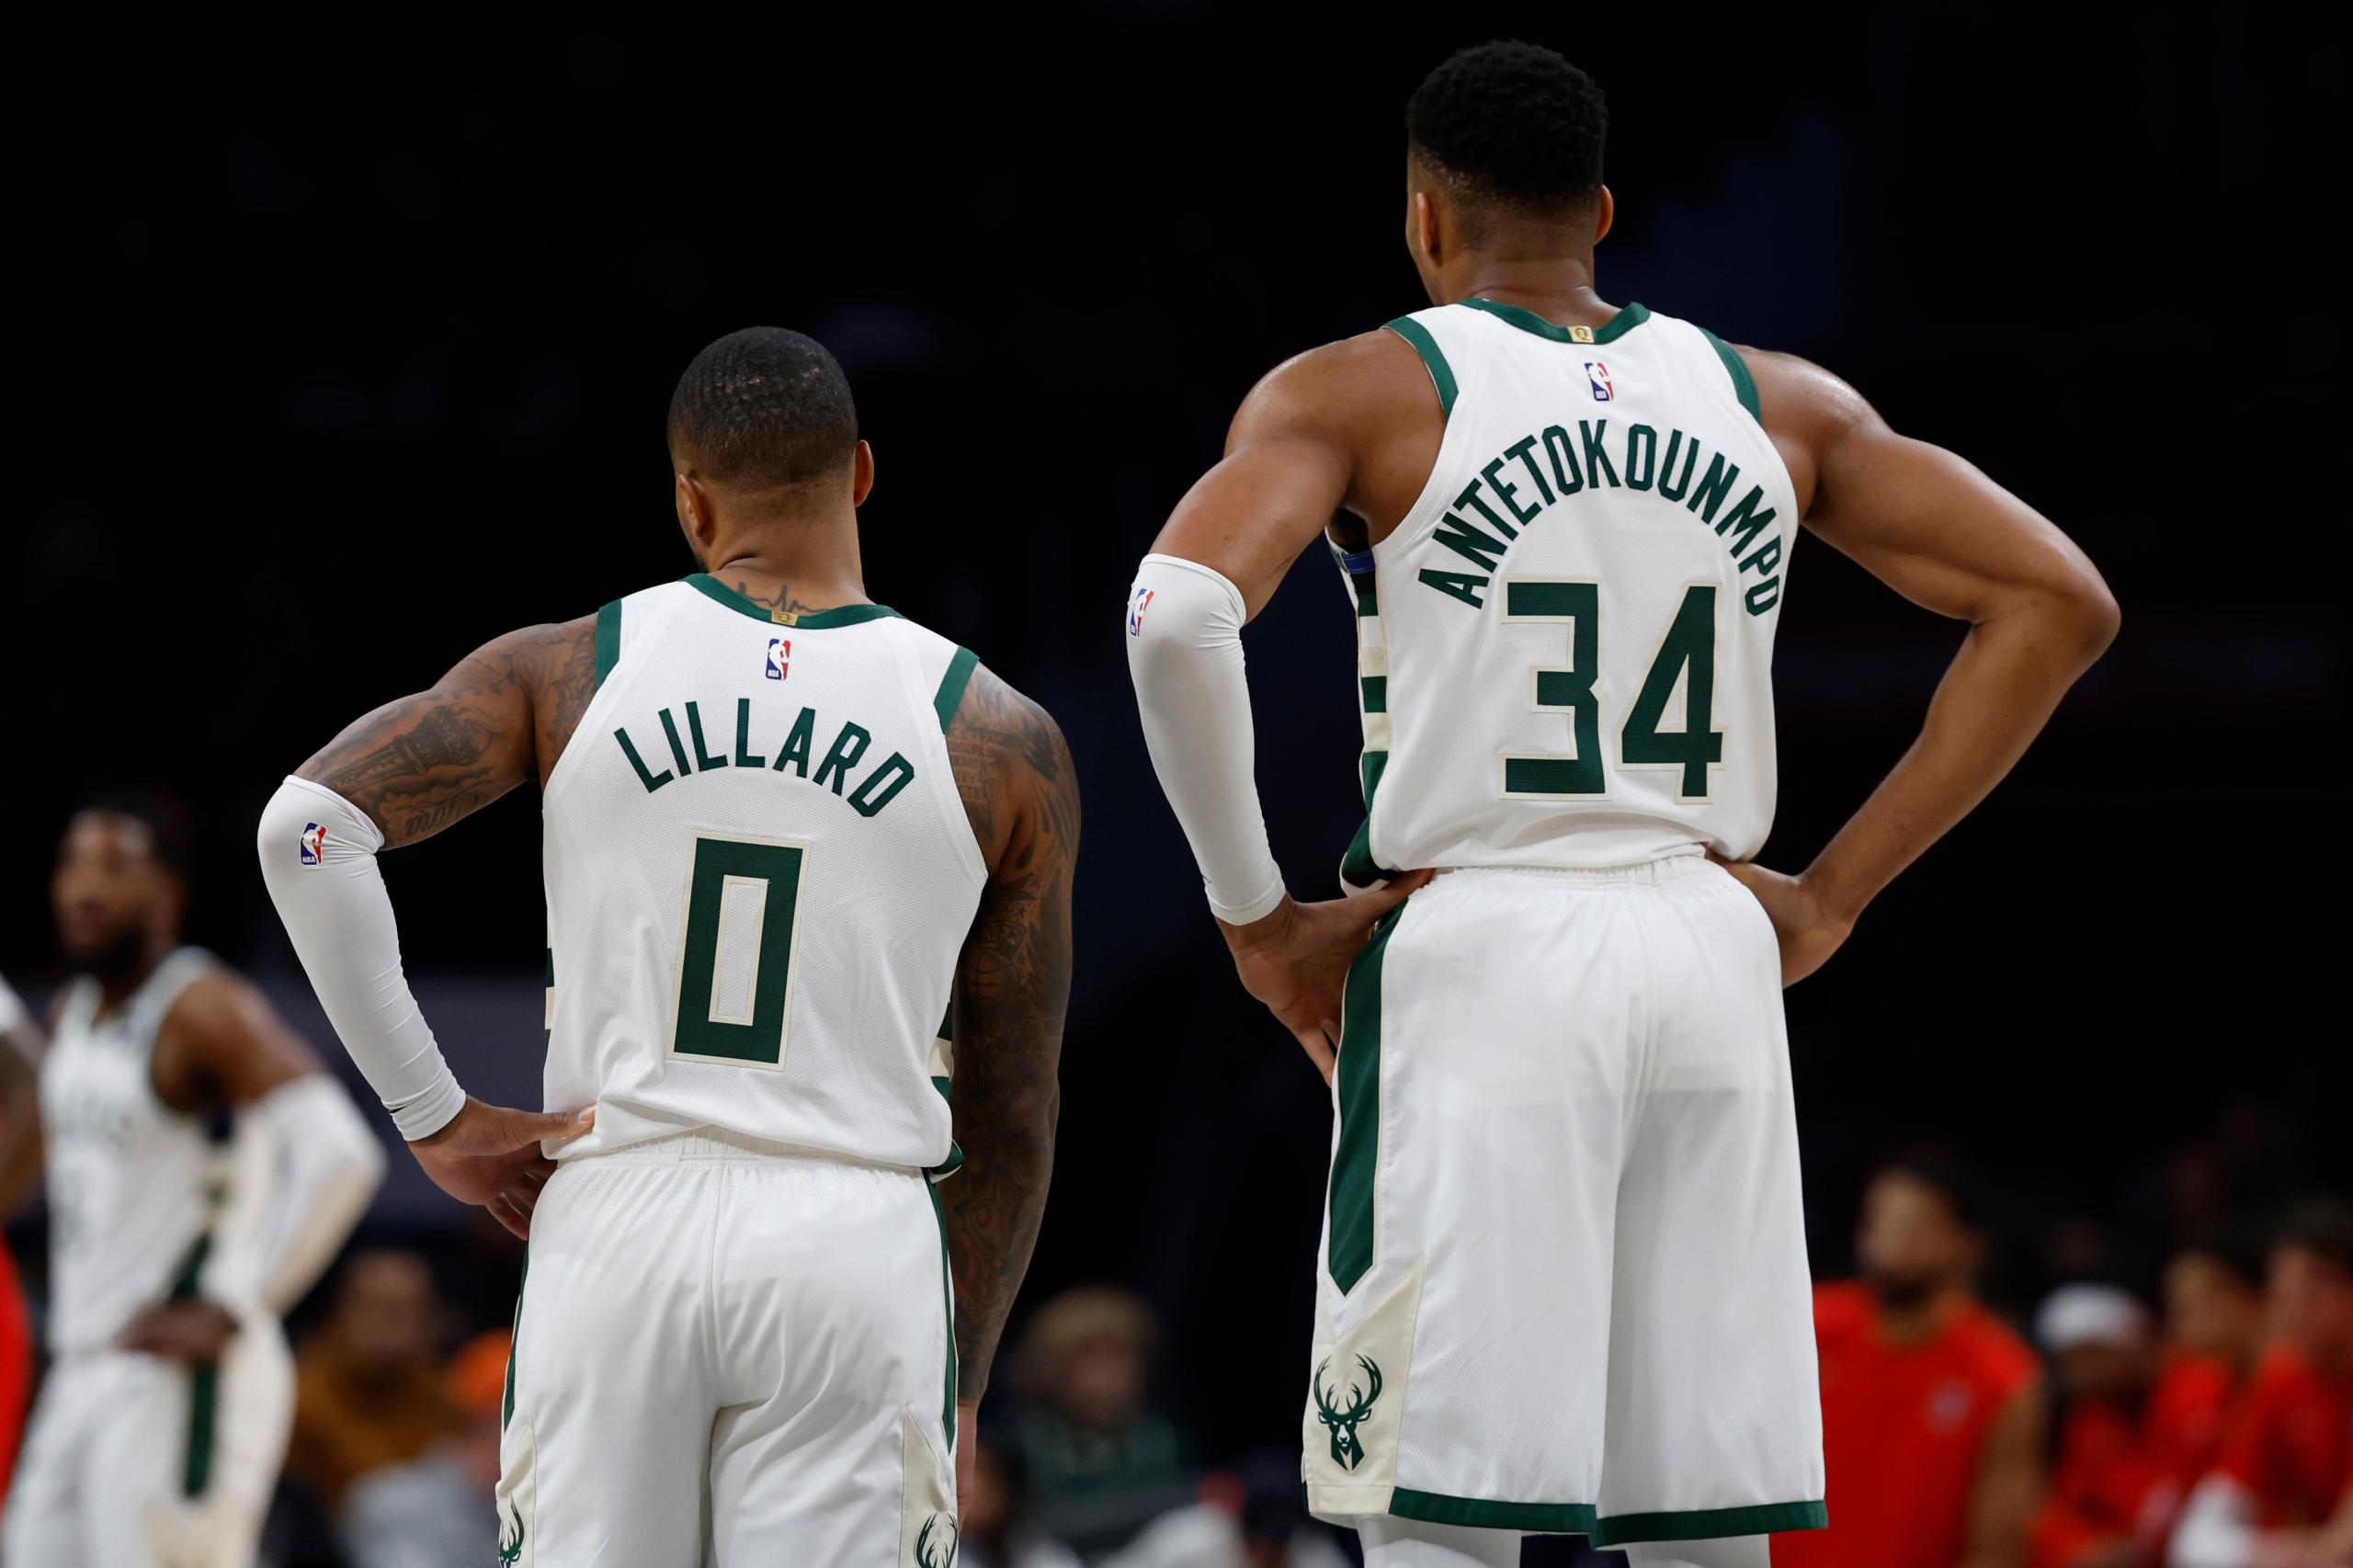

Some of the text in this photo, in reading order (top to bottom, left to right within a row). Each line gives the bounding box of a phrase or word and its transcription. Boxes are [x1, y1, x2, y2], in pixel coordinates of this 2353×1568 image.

[1418, 419, 1781, 616] ANTETOKOUNMPO
[767, 669, 779, 677] NBA
[1504, 581, 1725, 799] 34
[614, 698, 915, 818] LILLARD
[302, 856, 316, 864] NBA
[671, 835, 806, 1066] 0
